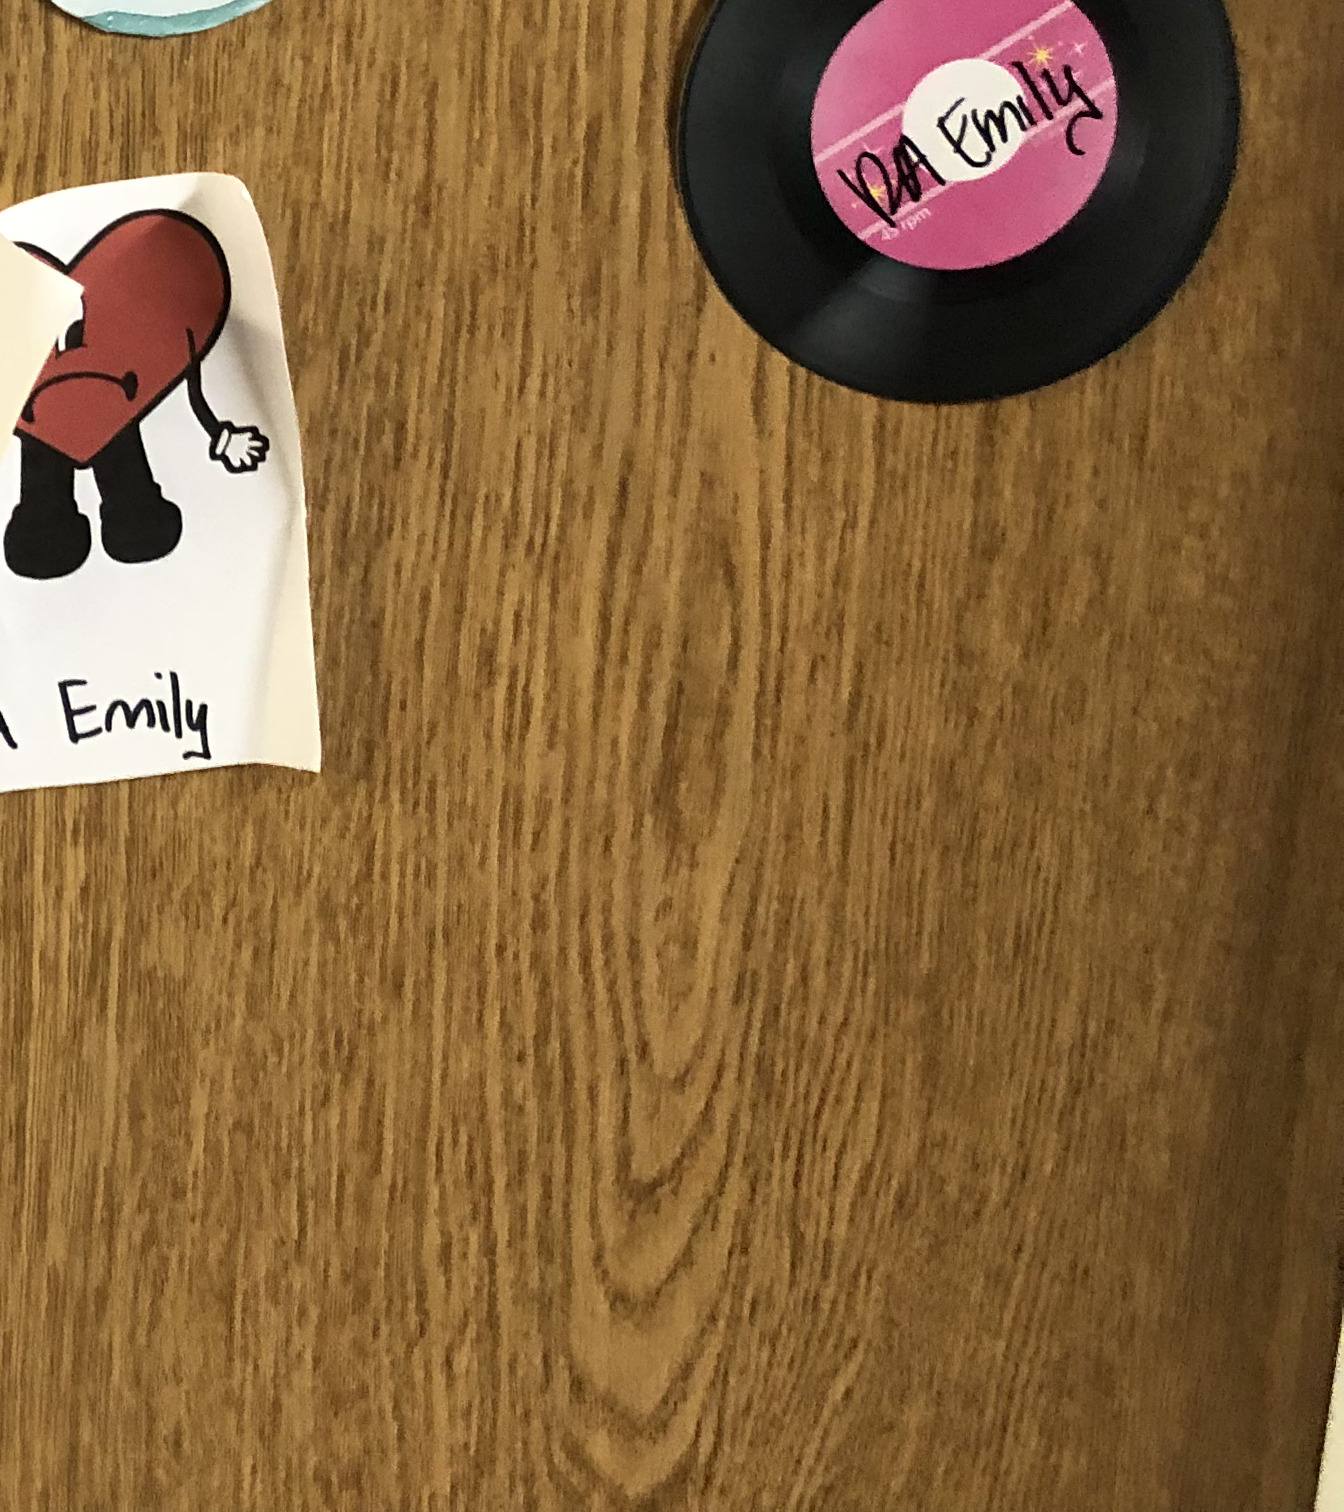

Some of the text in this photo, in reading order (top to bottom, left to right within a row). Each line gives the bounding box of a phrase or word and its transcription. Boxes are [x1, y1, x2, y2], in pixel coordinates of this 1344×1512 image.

[837, 60, 1104, 228] RA Emily
[58, 671, 211, 759] Emily
